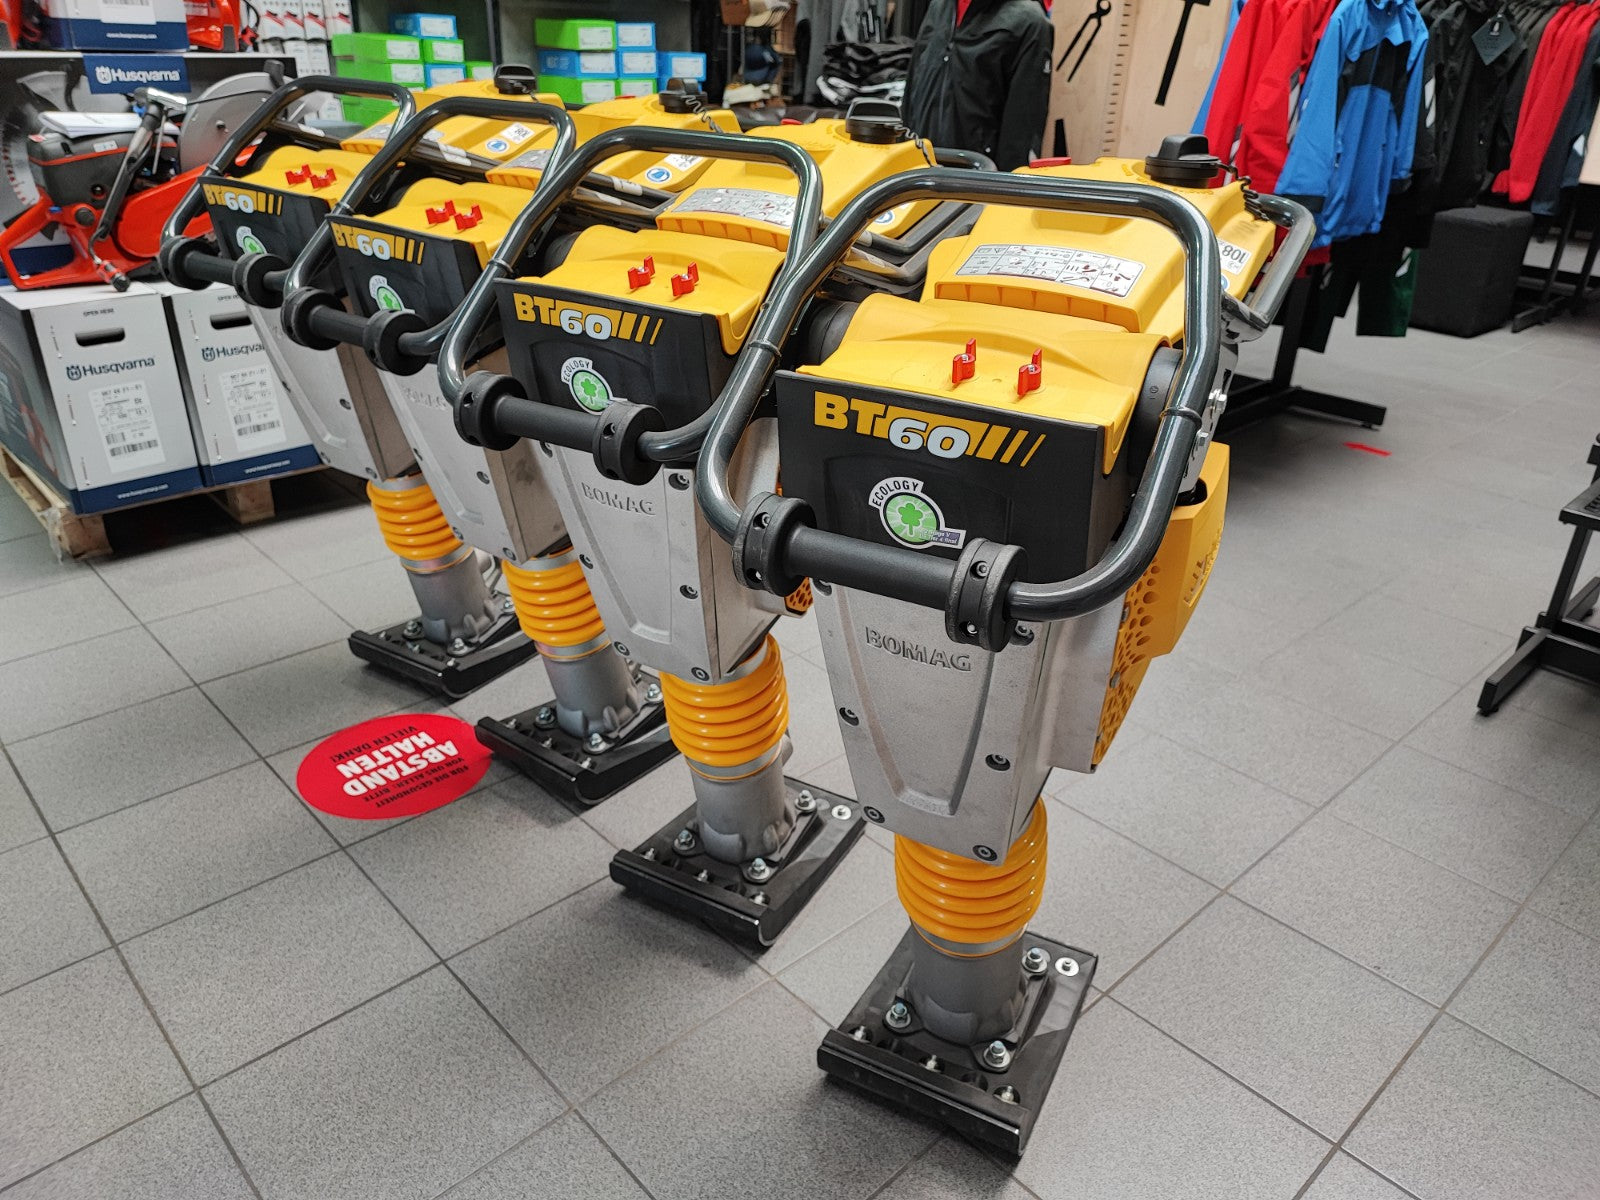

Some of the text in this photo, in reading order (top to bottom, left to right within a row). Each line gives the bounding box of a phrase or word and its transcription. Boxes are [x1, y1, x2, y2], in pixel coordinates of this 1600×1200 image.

[111, 68, 180, 83] Husqvarna
[513, 292, 613, 340] BT60
[82, 357, 155, 377] Husqvarna
[563, 359, 590, 383] ECOLOGY
[814, 390, 971, 459] BT60
[581, 482, 657, 516] BOMAG
[872, 479, 920, 507] ECOLOGY
[865, 626, 971, 672] BOMAG
[372, 725, 418, 746] VIELEN
[335, 731, 436, 778] HALTEN
[342, 740, 459, 796] ABSTAND
